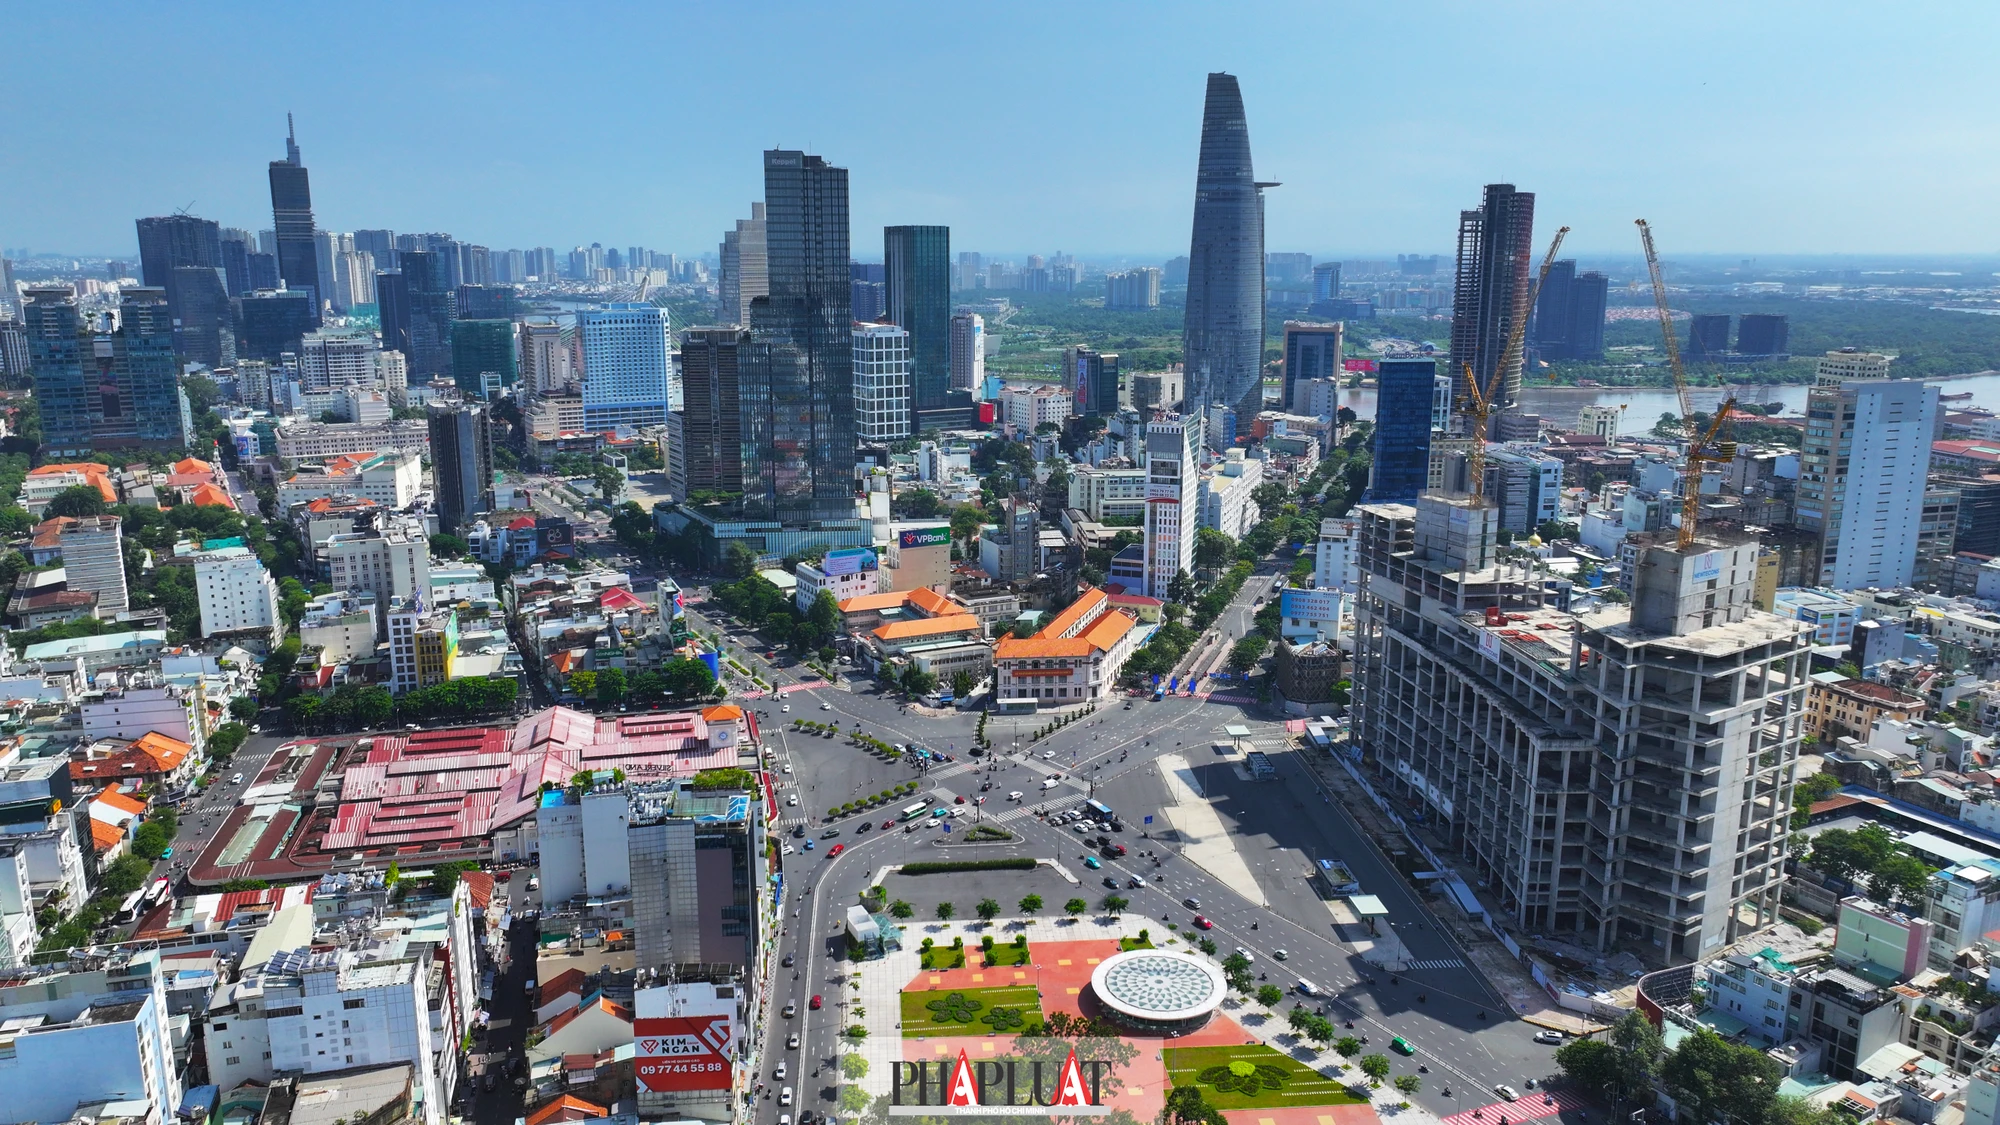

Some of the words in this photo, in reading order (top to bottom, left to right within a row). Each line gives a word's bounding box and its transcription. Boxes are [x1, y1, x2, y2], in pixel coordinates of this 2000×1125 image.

[1165, 413, 1180, 421] MB
[916, 533, 947, 544] VPBank
[662, 1038, 687, 1047] KIM
[662, 1045, 700, 1054] NGAN
[641, 1066, 656, 1075] 09
[657, 1065, 672, 1074] 77
[673, 1064, 688, 1073] 44
[690, 1063, 705, 1073] 55
[707, 1062, 722, 1072] 88
